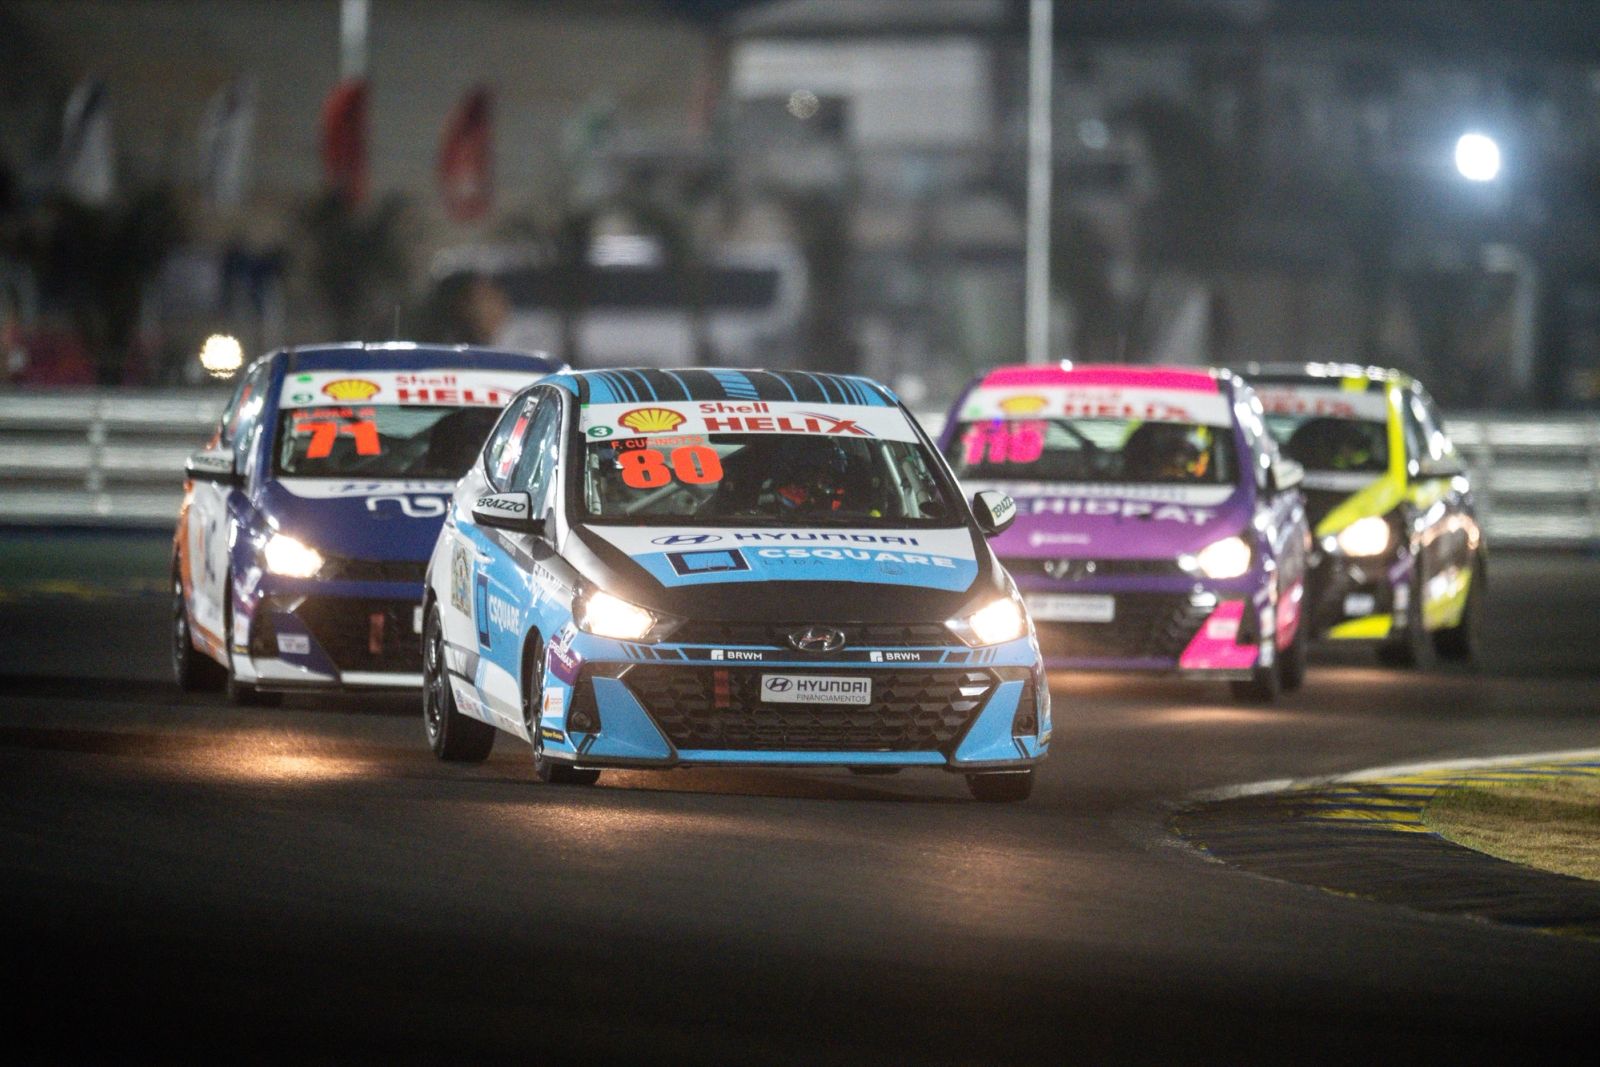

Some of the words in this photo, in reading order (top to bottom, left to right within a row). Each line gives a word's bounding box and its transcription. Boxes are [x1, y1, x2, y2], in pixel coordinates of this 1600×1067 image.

[395, 374, 457, 386] Shell
[397, 388, 504, 404] HELI
[699, 402, 770, 415] Shell
[594, 427, 608, 438] 3
[701, 416, 868, 436] HELIX
[295, 420, 382, 459] 71
[618, 445, 724, 489] 80
[476, 498, 526, 513] BRAZZO
[734, 533, 919, 546] HYUNDAI
[758, 549, 957, 569] CSQUARE
[727, 651, 763, 661] BRWM
[886, 652, 920, 661] BRWM
[797, 680, 867, 693] HYUNDAI
[796, 694, 867, 703] FINANCIAMENTOS
